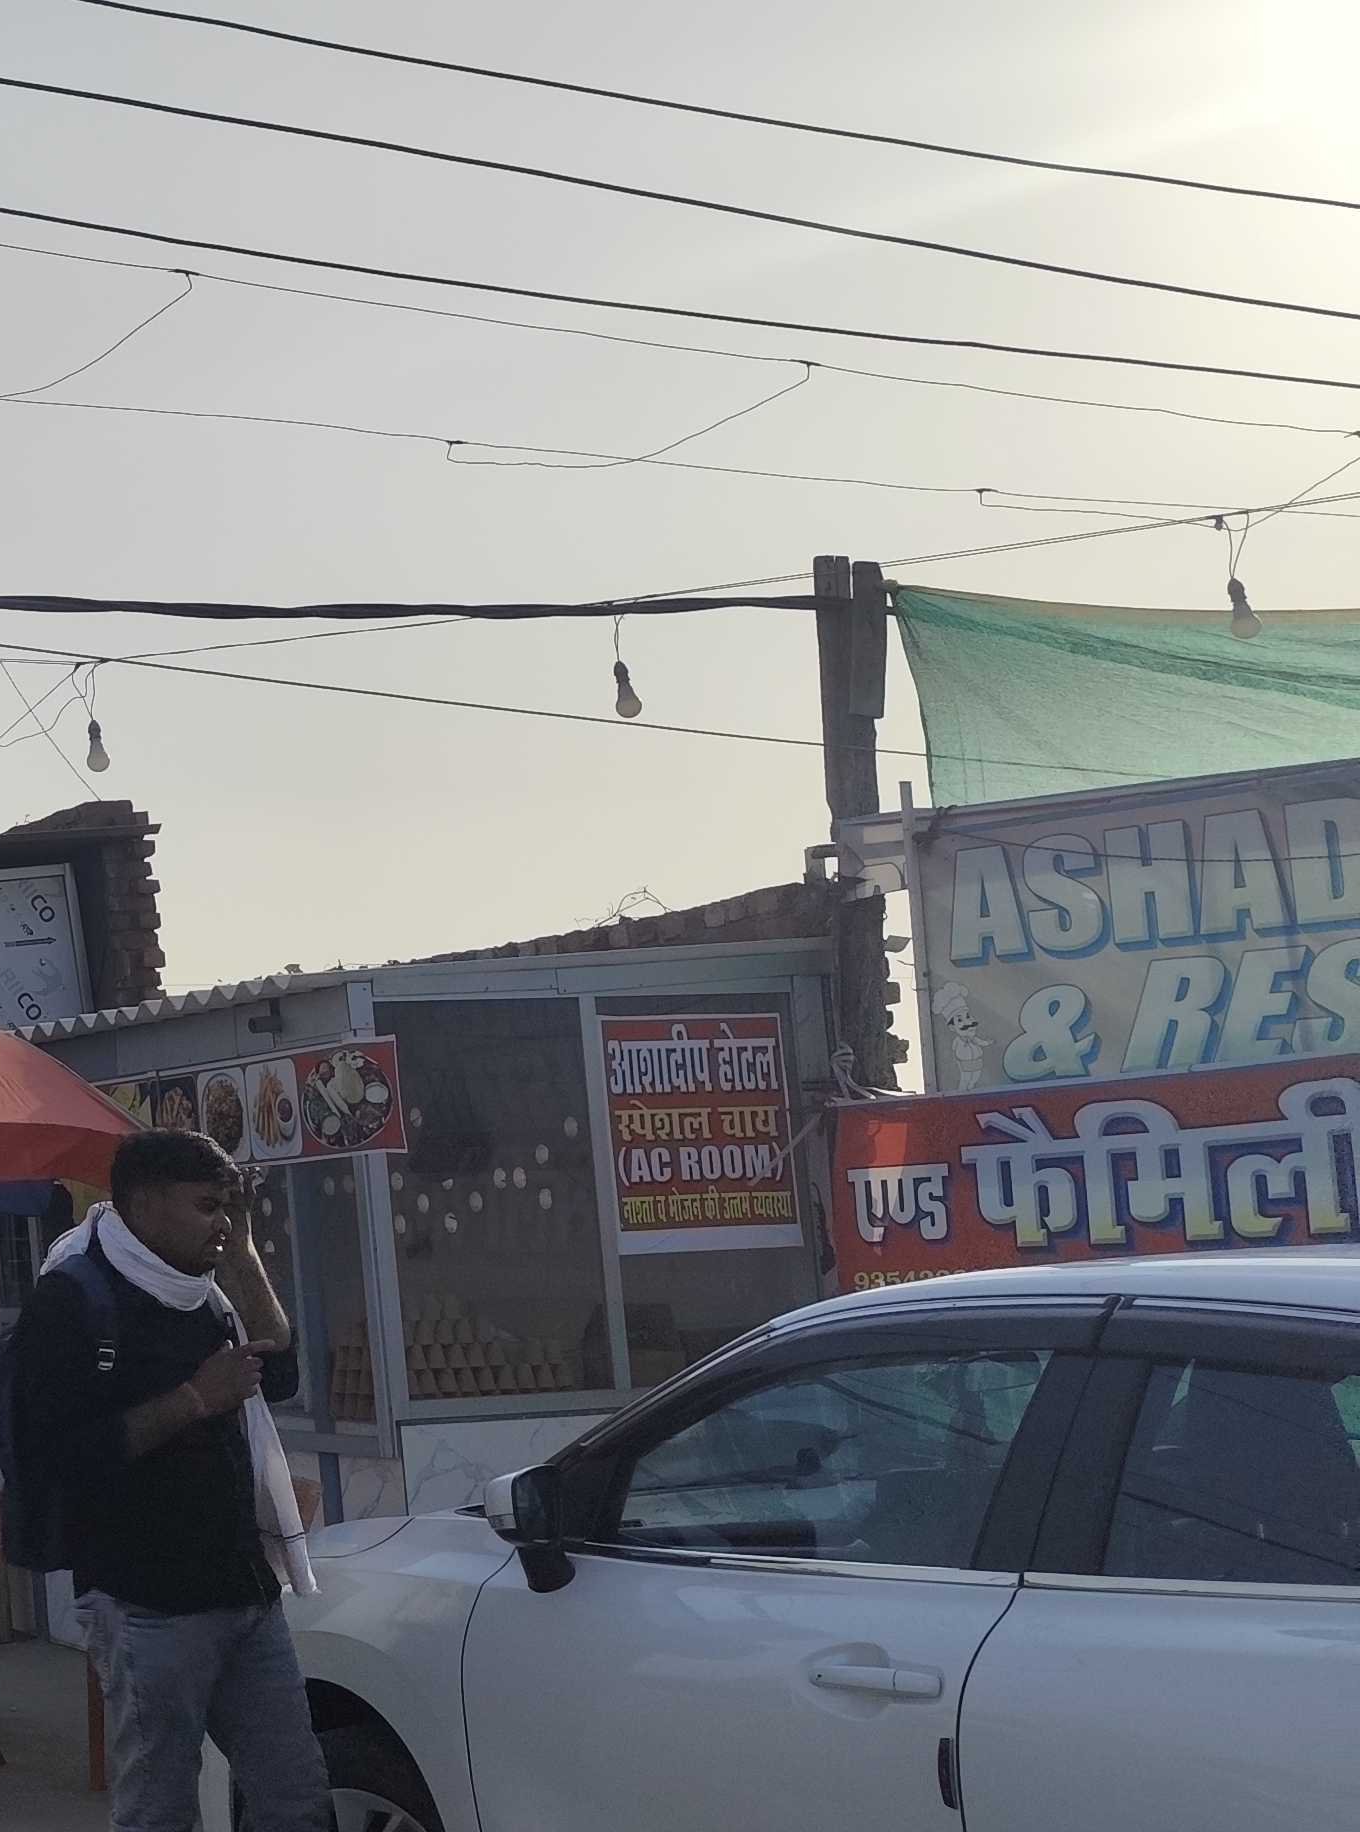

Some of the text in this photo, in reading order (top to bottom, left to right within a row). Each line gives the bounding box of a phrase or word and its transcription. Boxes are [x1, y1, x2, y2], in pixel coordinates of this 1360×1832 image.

[607, 1022, 779, 1095] आशादीप होटल
[1003, 983, 1102, 1083] &
[614, 1100, 778, 1142] स्पेशल चाय
[618, 1142, 785, 1186] (AC ROOM)
[961, 1078, 1360, 1248] फैमिली
[702, 1186, 721, 1220] की
[720, 1191, 751, 1219] उत्तम
[847, 1162, 950, 1243] एण्ड
